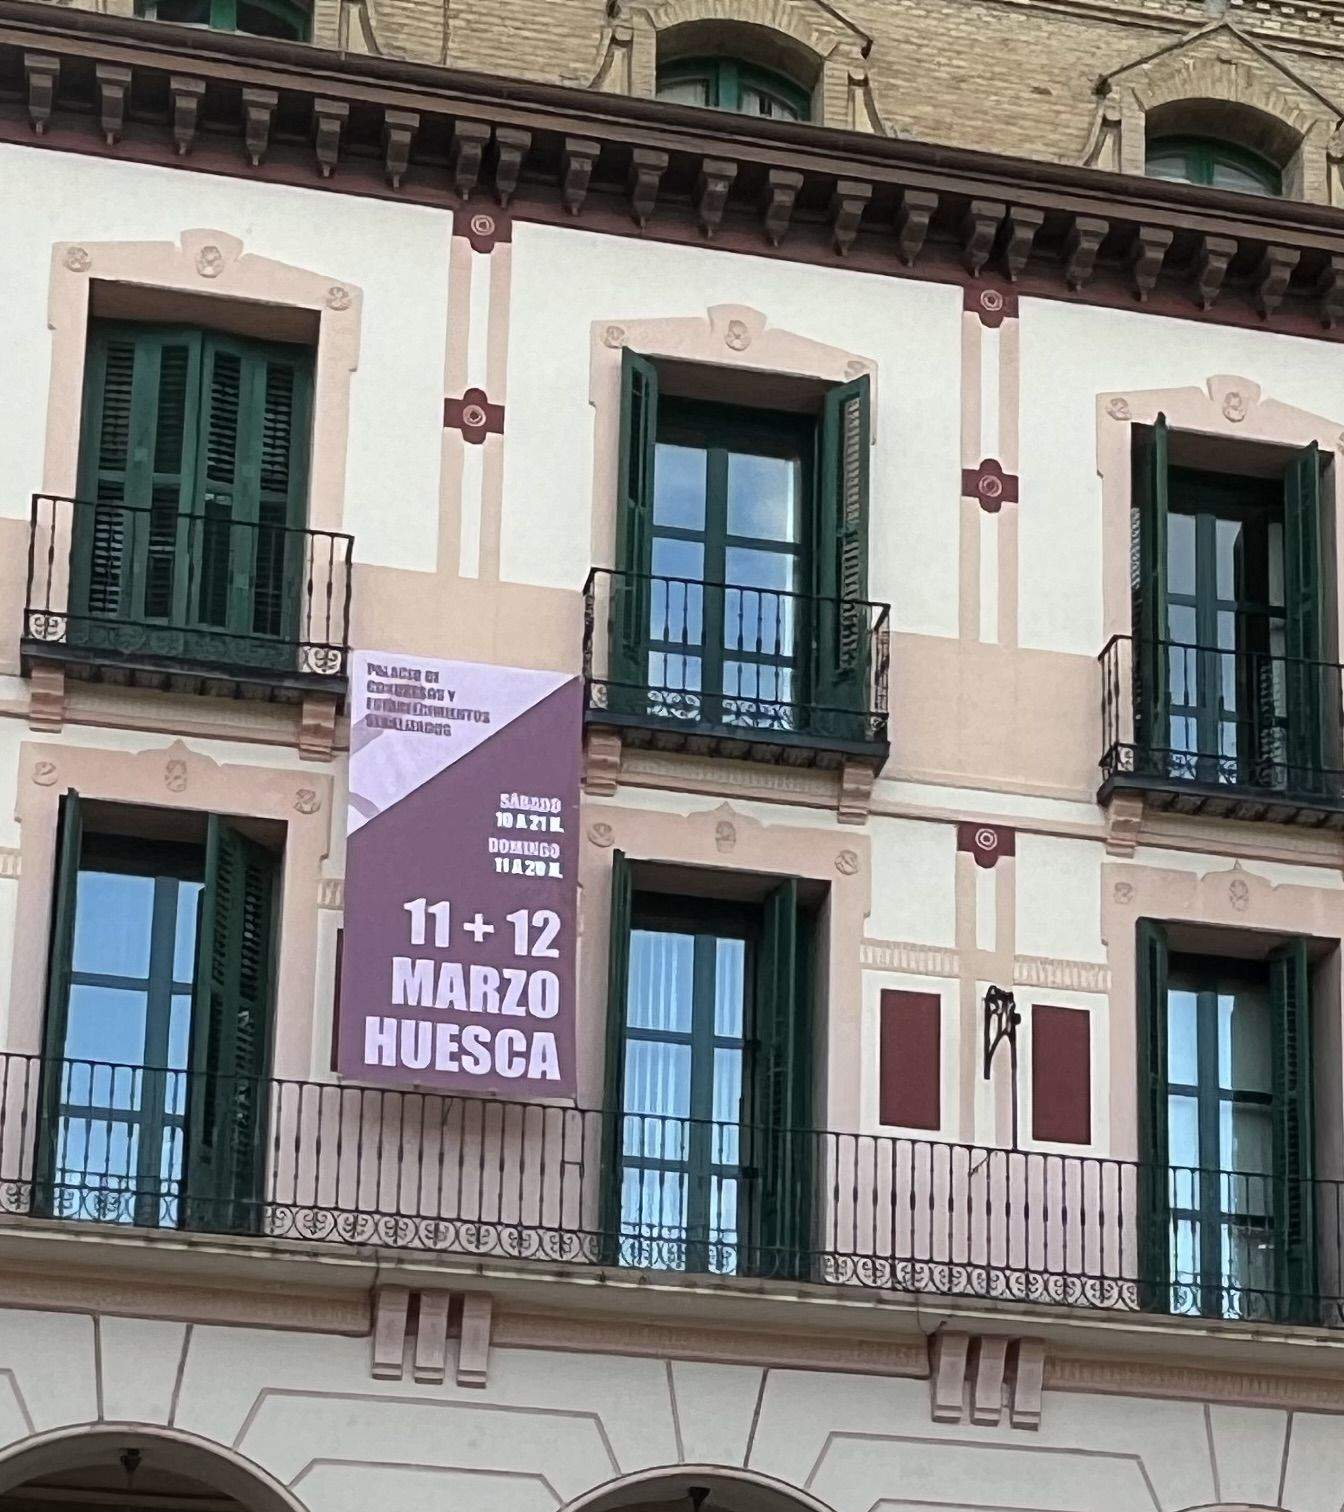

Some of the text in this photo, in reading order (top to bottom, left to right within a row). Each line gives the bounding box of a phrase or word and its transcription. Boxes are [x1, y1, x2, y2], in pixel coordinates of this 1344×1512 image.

[500, 792, 562, 814] SÁBADO
[495, 811, 514, 829] 10
[516, 813, 528, 829] A
[529, 814, 547, 832] 21
[488, 837, 561, 859] DOMINGO
[494, 857, 510, 873] 11
[511, 858, 524, 875] A
[403, 898, 451, 948] 11
[506, 909, 561, 959] 12
[391, 956, 561, 1020] MARZO
[364, 1015, 562, 1081] HUESCA
